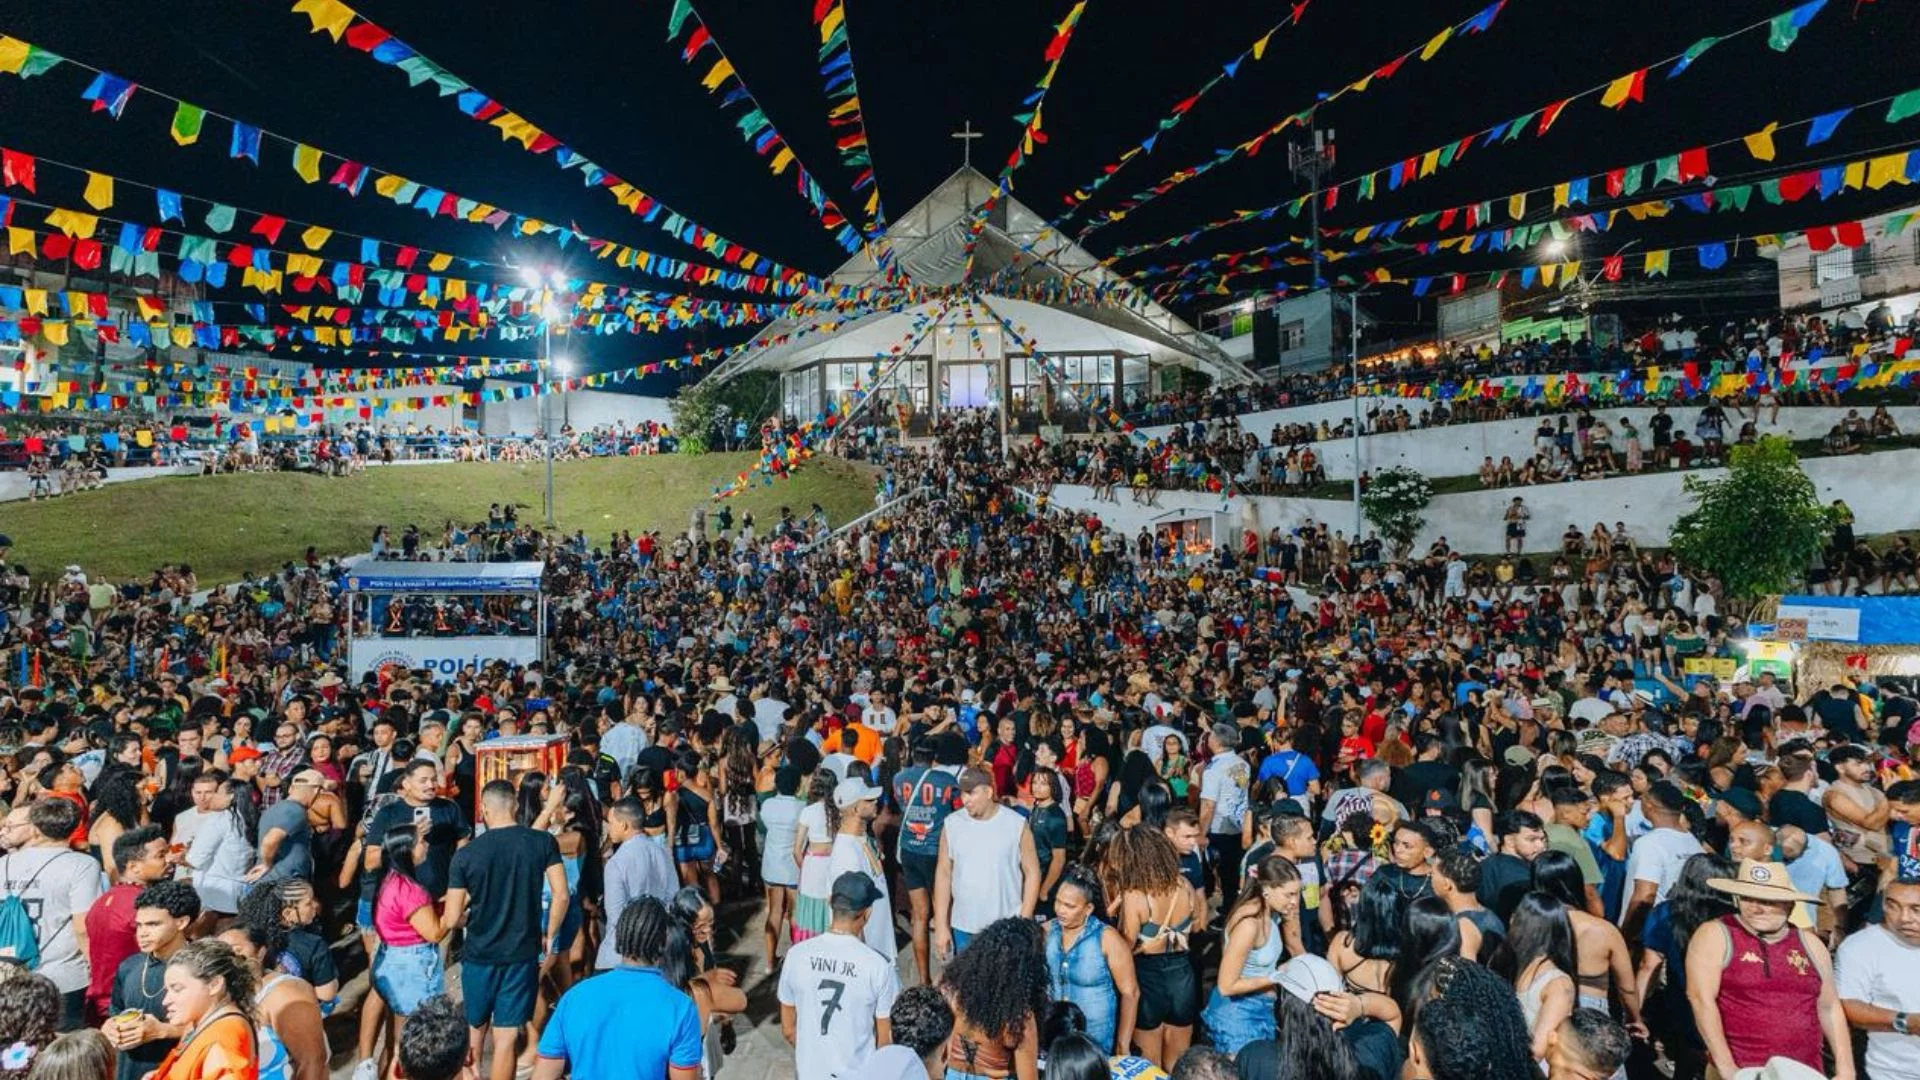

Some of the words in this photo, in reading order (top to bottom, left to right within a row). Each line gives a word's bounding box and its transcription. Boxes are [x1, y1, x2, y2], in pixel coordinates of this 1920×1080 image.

[423, 653, 519, 674] POLÍCA
[810, 956, 837, 974] VINI
[840, 961, 858, 978] JR.
[817, 978, 846, 1036] 7
